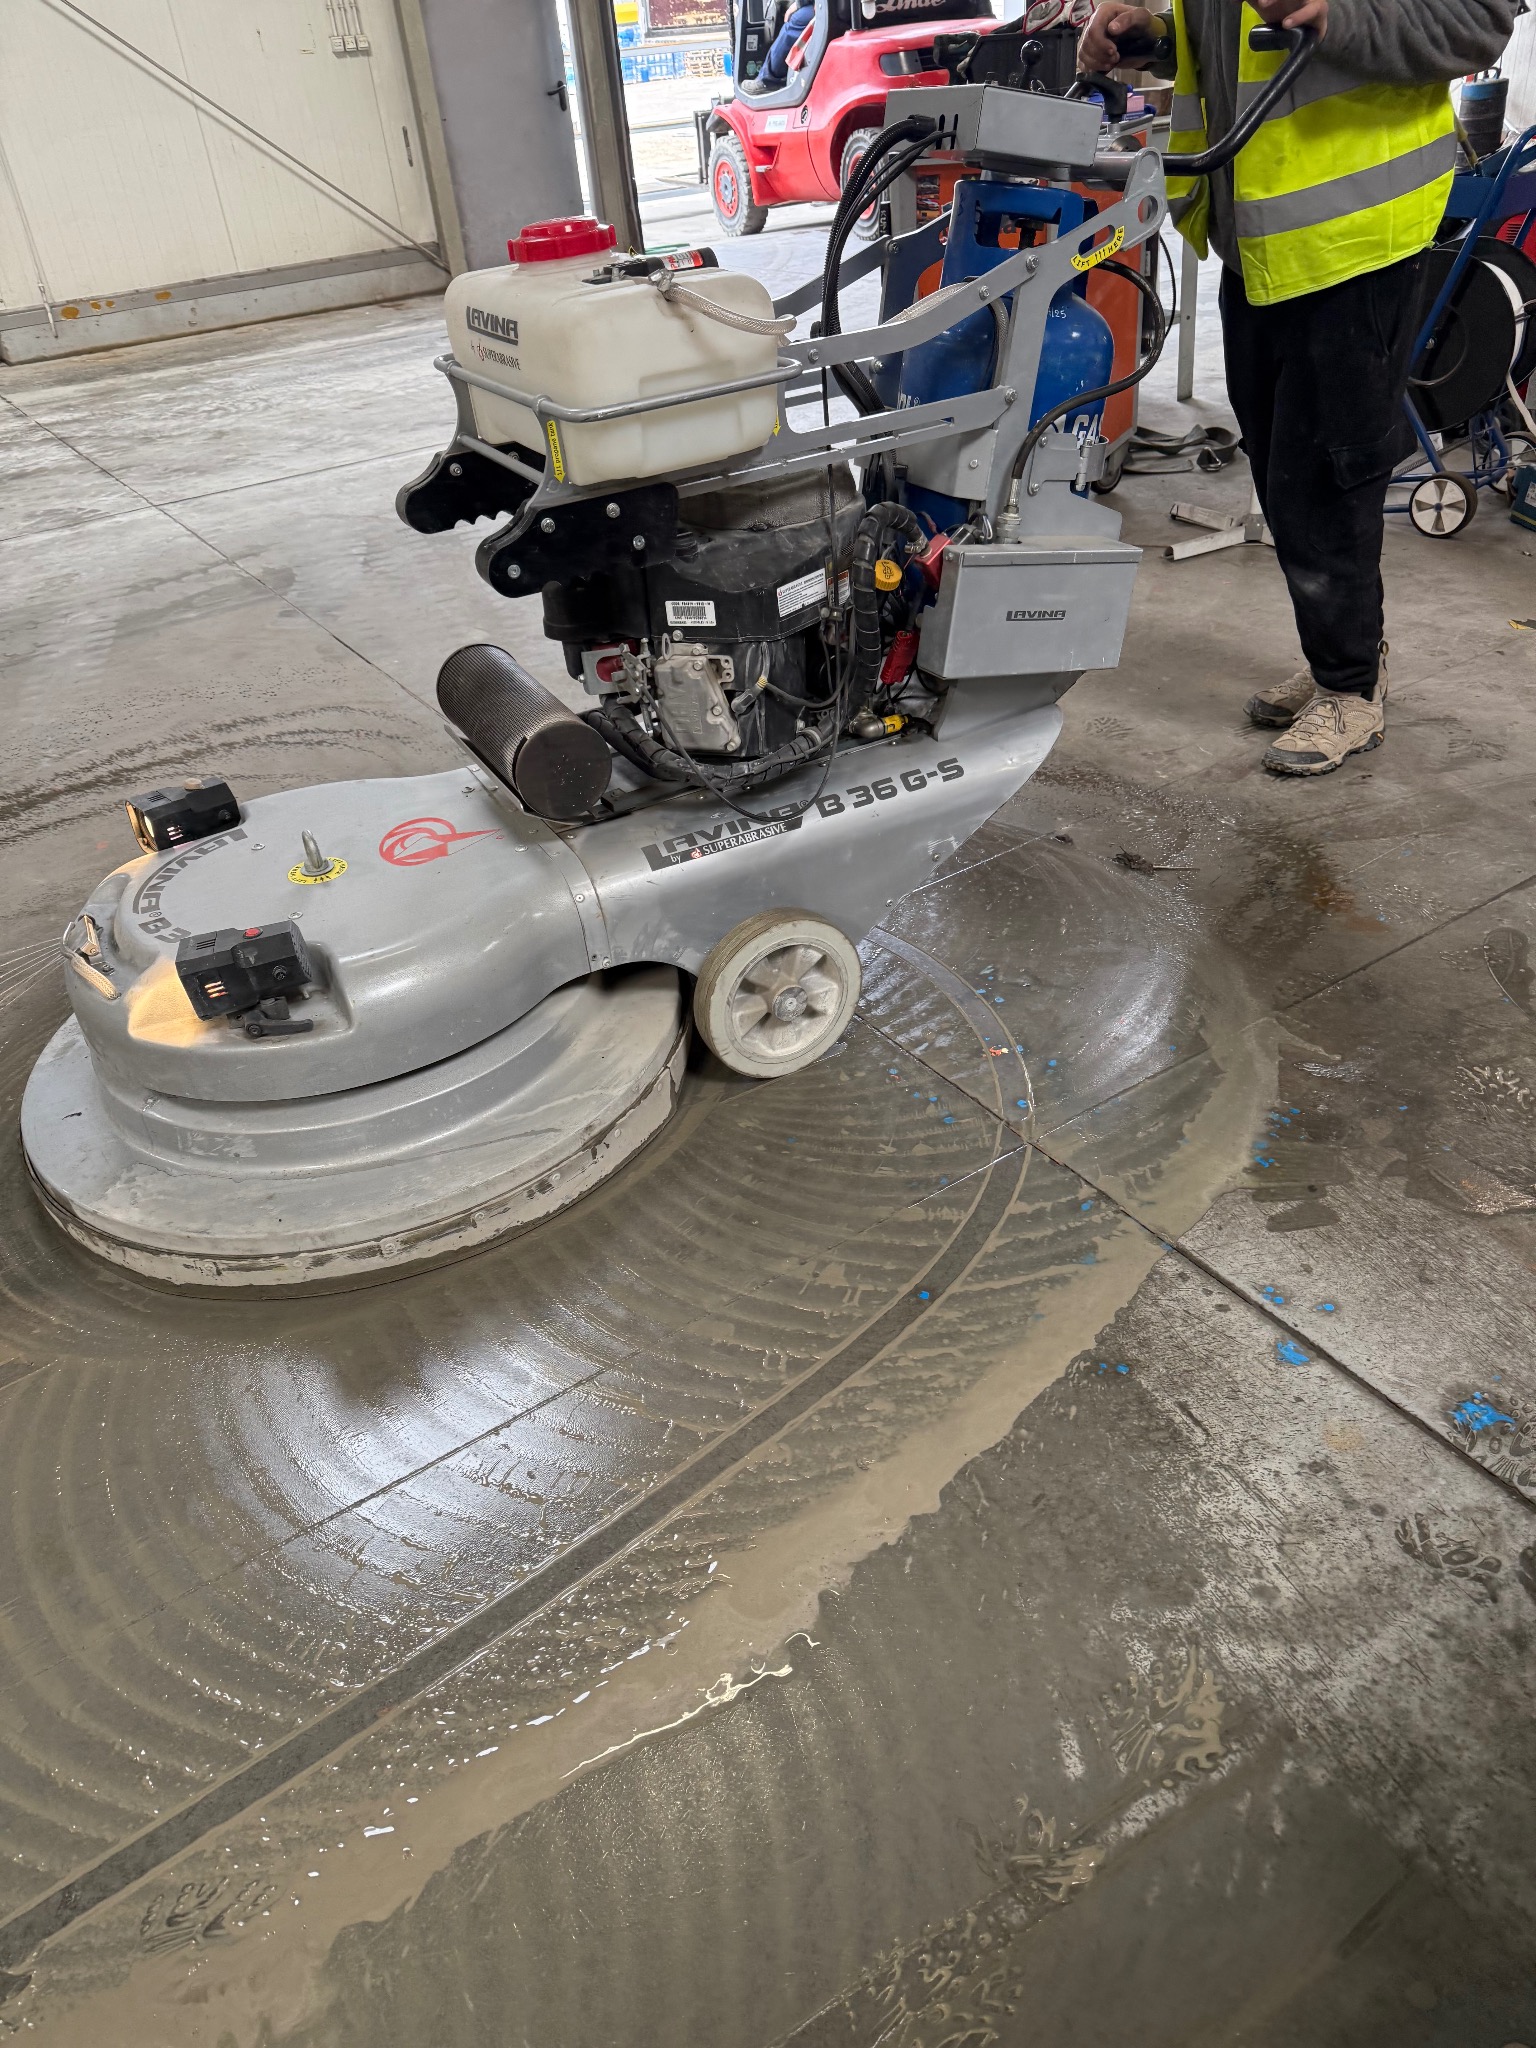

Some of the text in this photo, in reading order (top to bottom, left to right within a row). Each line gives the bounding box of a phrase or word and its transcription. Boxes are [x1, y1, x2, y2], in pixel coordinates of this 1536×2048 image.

[1107, 227, 1124, 254] HERE
[466, 305, 519, 346] LAVINA
[1005, 610, 1066, 621] LAVINA
[846, 776, 898, 809] 36
[900, 757, 965, 793] G-S
[670, 822, 787, 864] by SUPERABRASIVE
